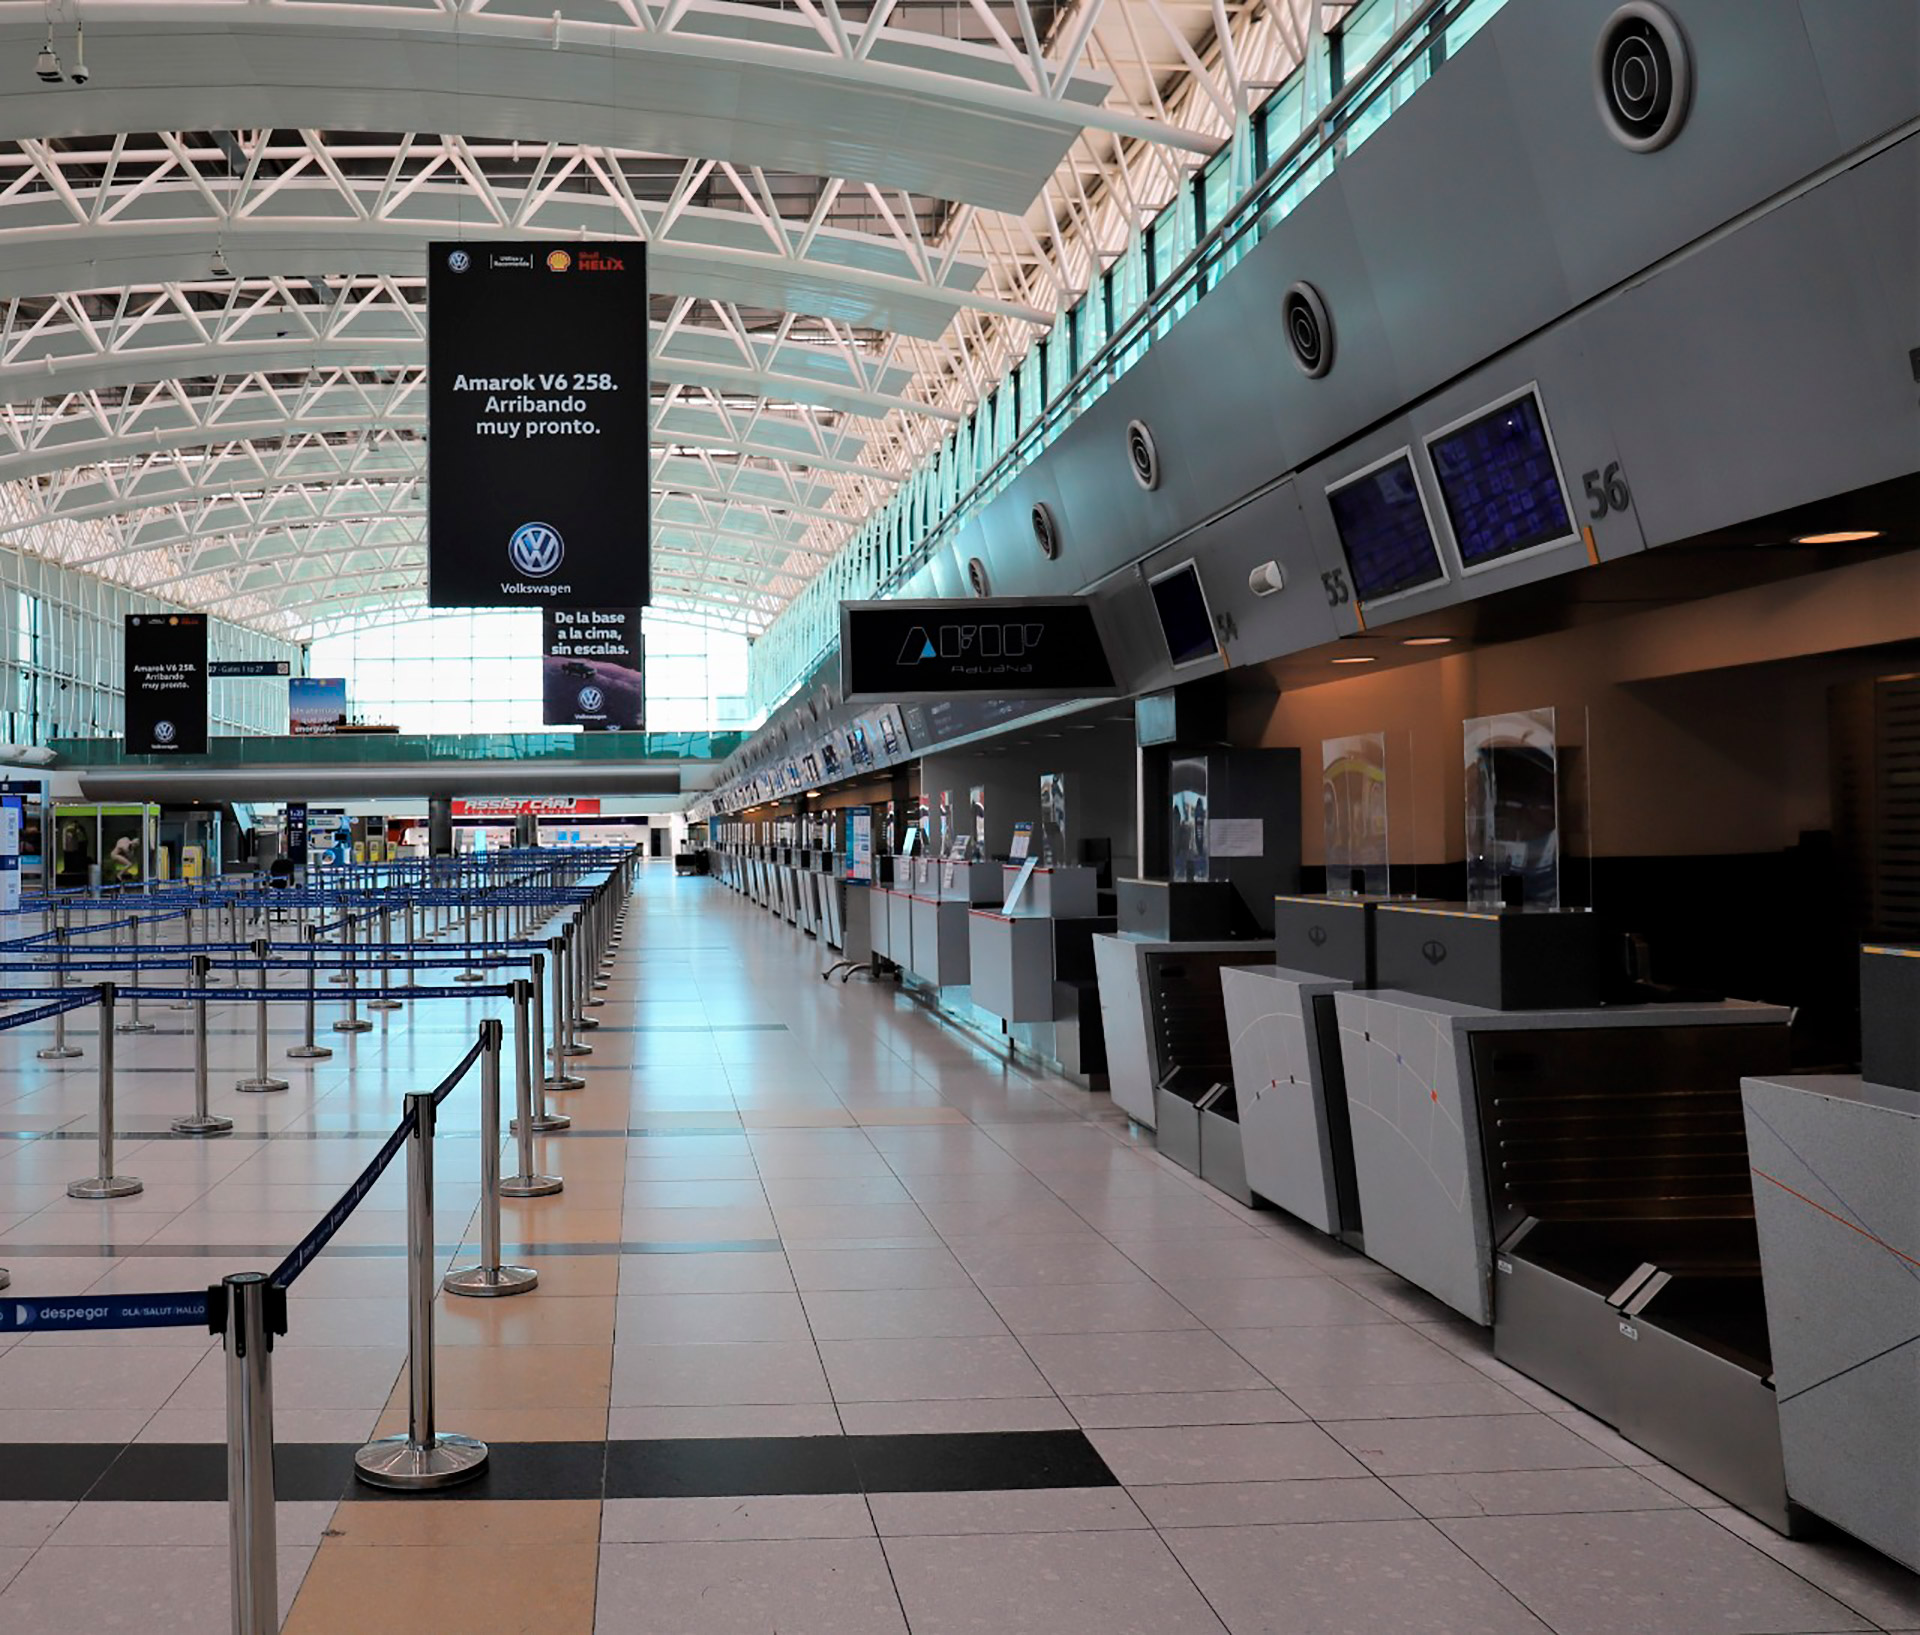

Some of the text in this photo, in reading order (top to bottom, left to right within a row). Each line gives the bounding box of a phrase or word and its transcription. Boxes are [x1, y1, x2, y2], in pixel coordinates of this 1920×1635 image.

[579, 261, 625, 271] HELIX
[453, 373, 619, 391] Amarok V6 258.
[484, 395, 587, 412] Arribando
[476, 419, 601, 438] muy pronto.
[1582, 461, 1629, 519] 56
[501, 583, 571, 595] Volkswagen
[1320, 567, 1349, 607] 55
[555, 612, 625, 623] De la base
[557, 627, 622, 641] a la cima,
[551, 643, 629, 655] sin escalas.
[896, 623, 1045, 665] AFIP
[465, 797, 528, 809] ASSIST
[40, 1307, 110, 1321] despegar
